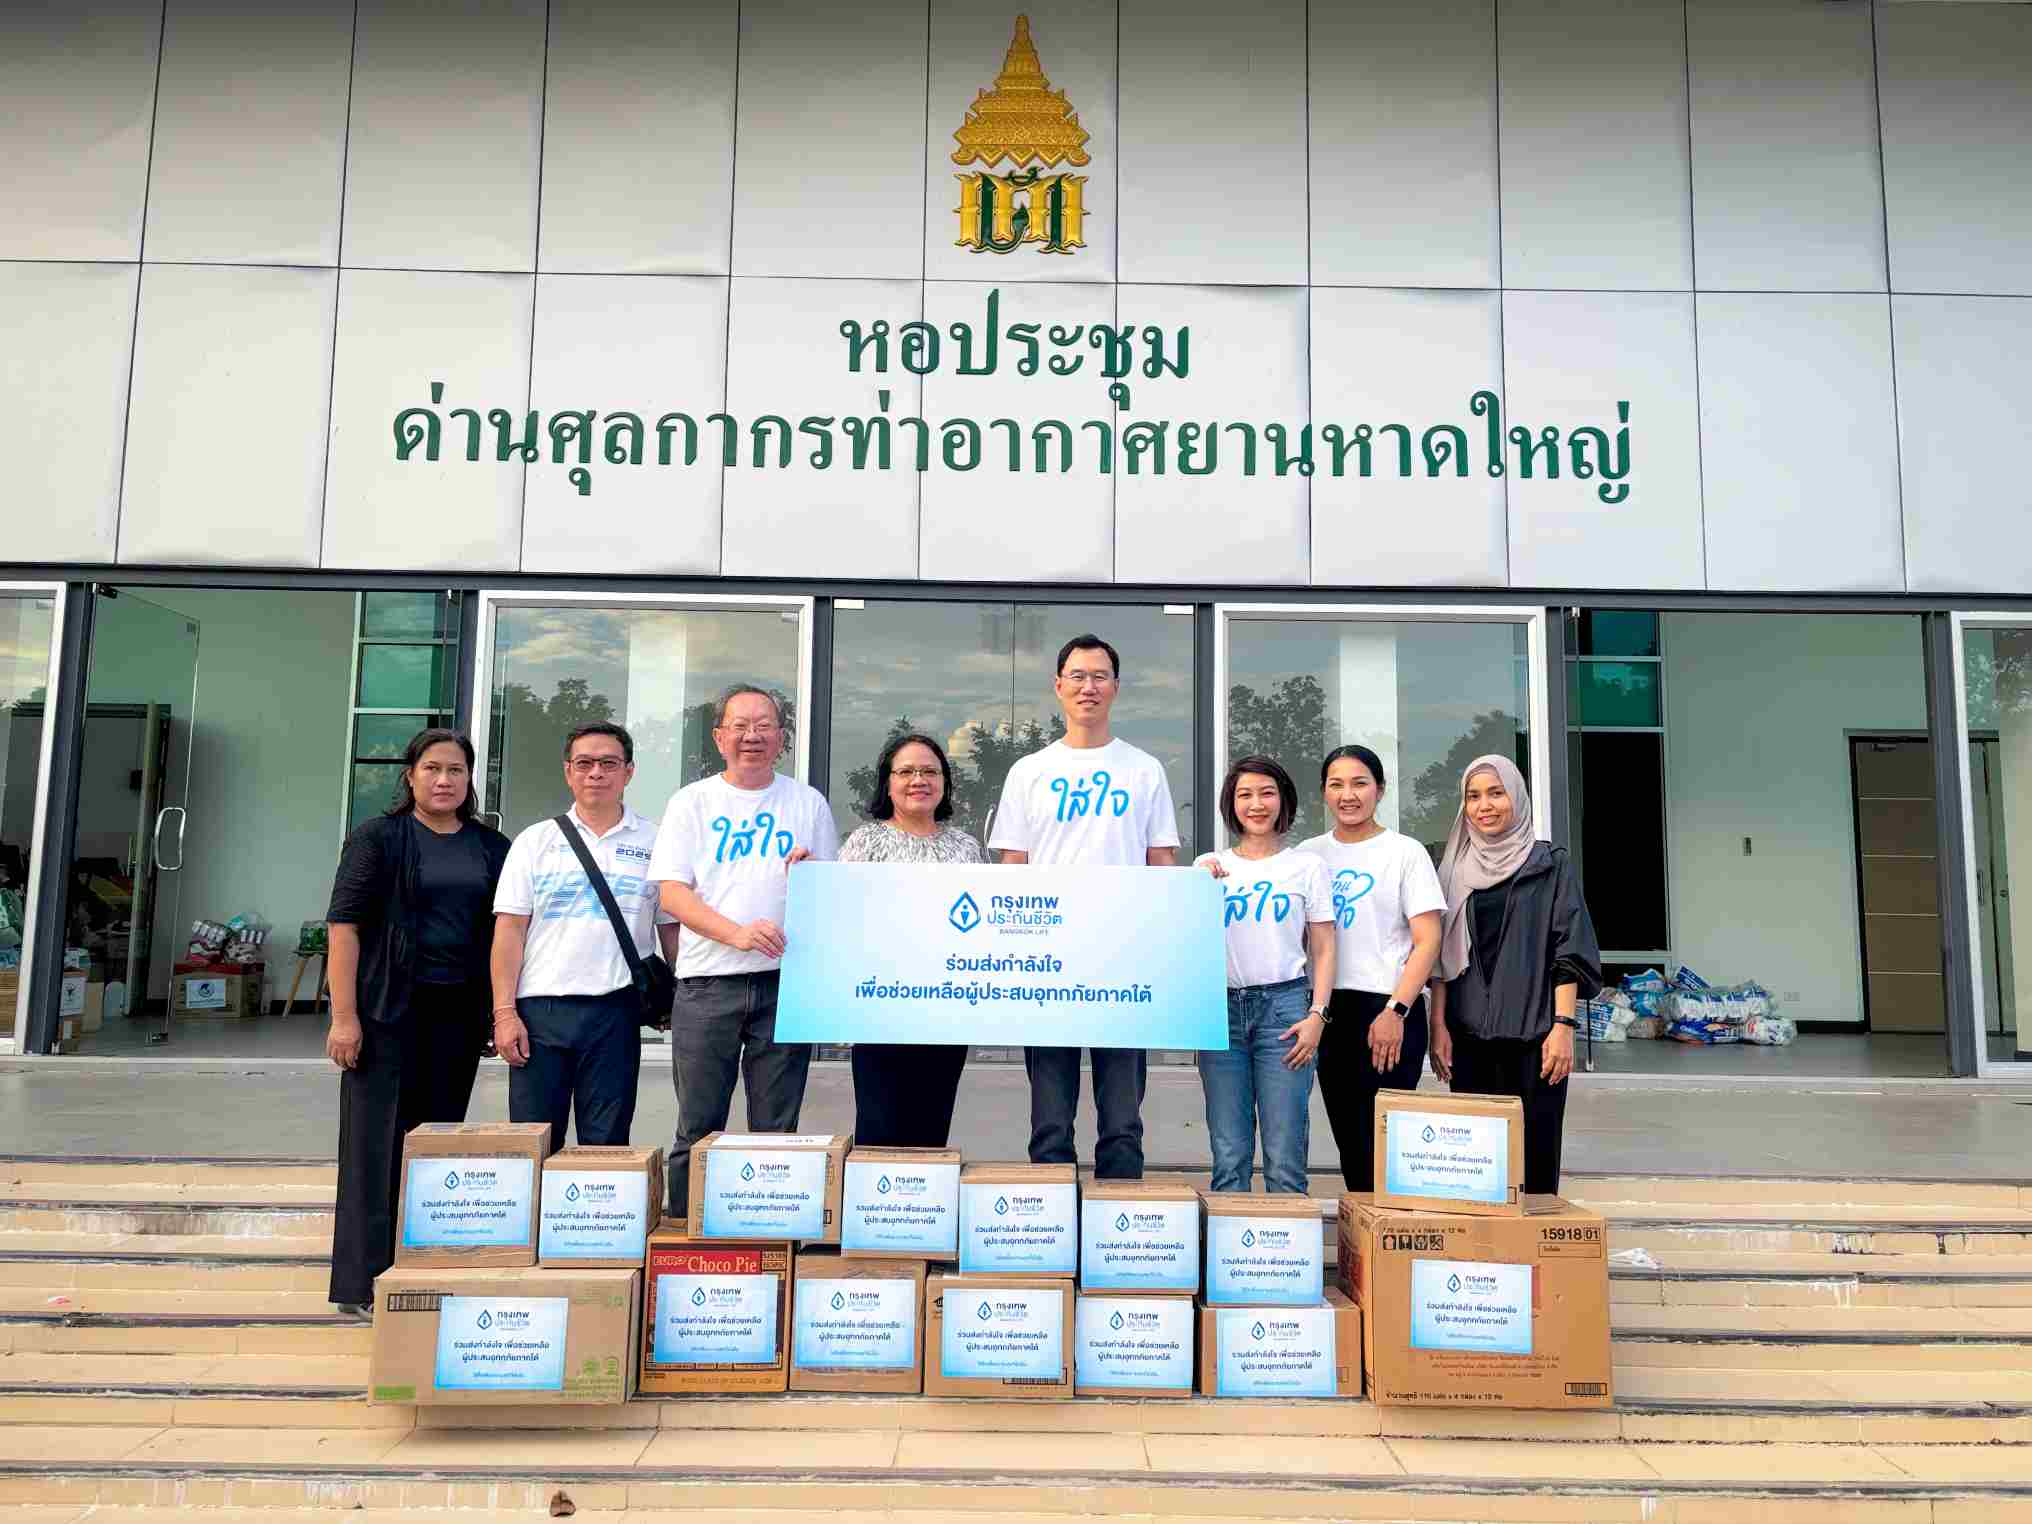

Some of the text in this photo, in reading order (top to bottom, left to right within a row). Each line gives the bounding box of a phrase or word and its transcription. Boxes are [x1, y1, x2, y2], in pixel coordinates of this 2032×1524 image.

[840, 288, 1189, 410] หอประชุม
[393, 382, 1630, 504] ด่านศุลกากรท่าอากาศยานหาดใหญ่
[1051, 770, 1130, 823] ใส่ใจ
[711, 812, 794, 864] ใส่ใจ
[990, 895, 1059, 911] กรุงเทพ
[987, 910, 1063, 926] ประกันชีวิต
[946, 953, 1063, 974] ร่วมส่งกำลังใจ
[854, 980, 1152, 1006] เพื่อช่วยเหลือผู้ประสบอุทกภัยภาคใต้
[1542, 1228, 1599, 1240] 15918 01
[688, 1255, 730, 1272] Choco
[735, 1256, 757, 1273] Pie
